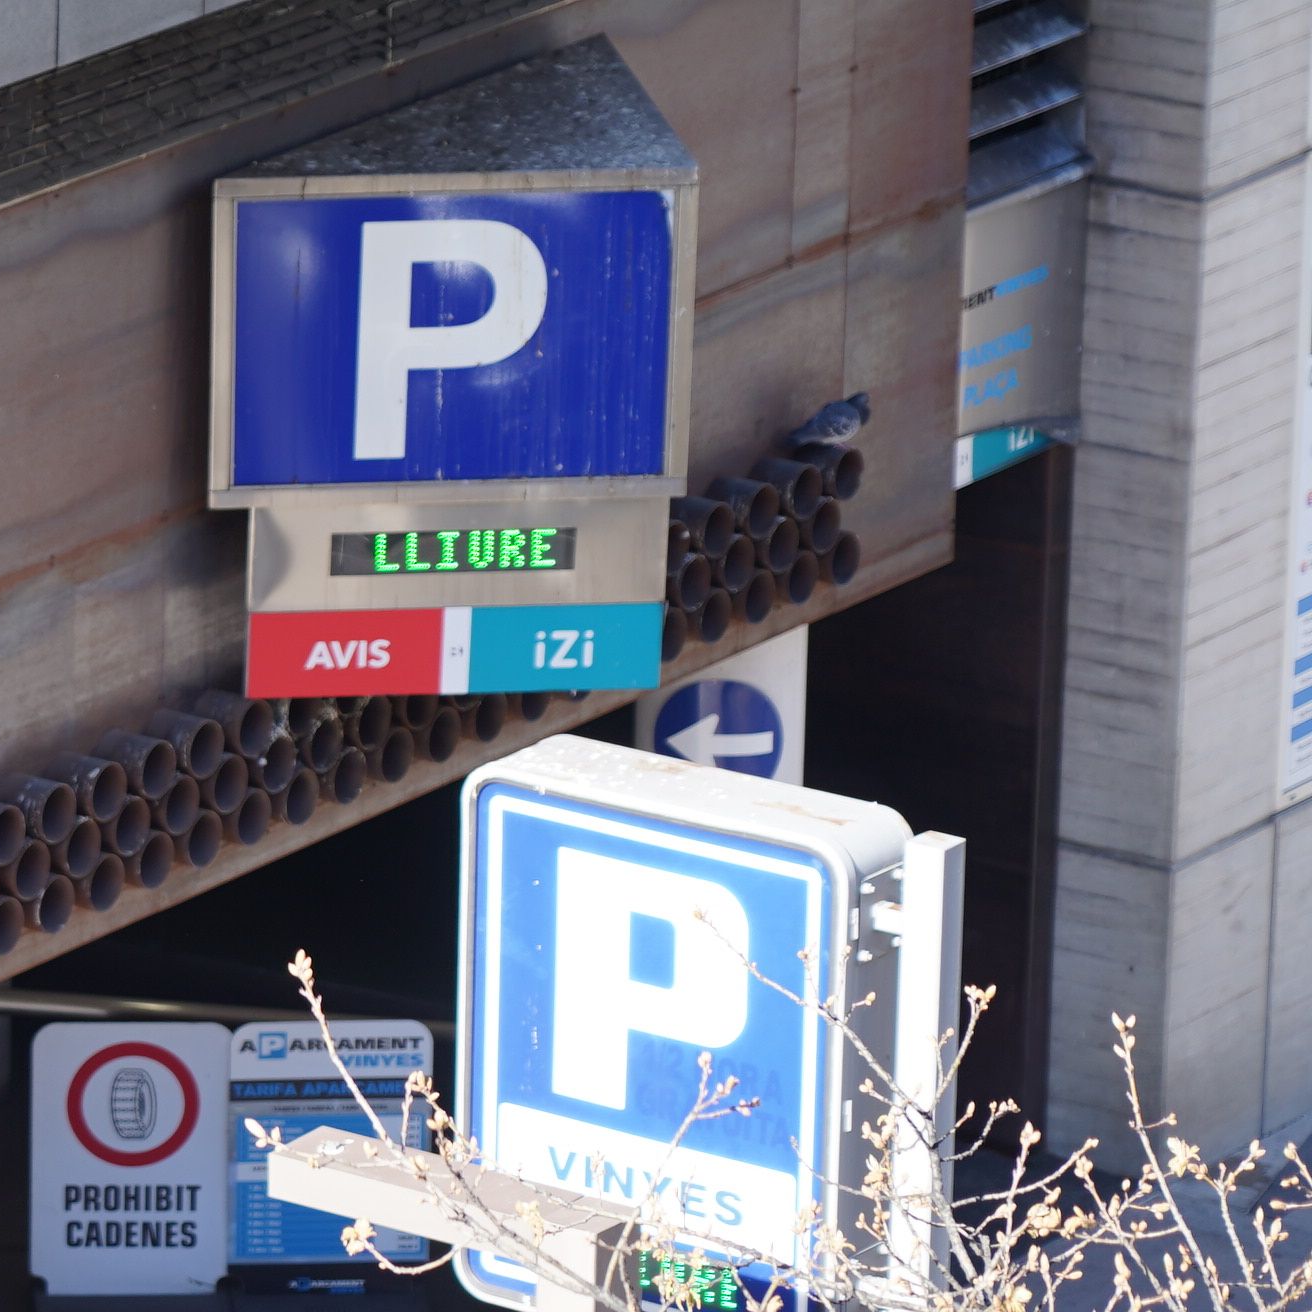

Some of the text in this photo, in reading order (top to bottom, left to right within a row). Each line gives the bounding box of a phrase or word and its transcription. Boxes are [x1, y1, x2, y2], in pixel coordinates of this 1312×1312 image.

[353, 218, 549, 461] P
[374, 528, 557, 572] LLIURE
[304, 638, 392, 671] AVIS
[552, 846, 750, 1111] P
[340, 1053, 424, 1068] VINYES
[233, 1083, 297, 1097] TARIFA
[64, 1184, 201, 1212] PROHIBIT
[548, 1145, 743, 1227] VINYES
[66, 1220, 197, 1248] CADENES
